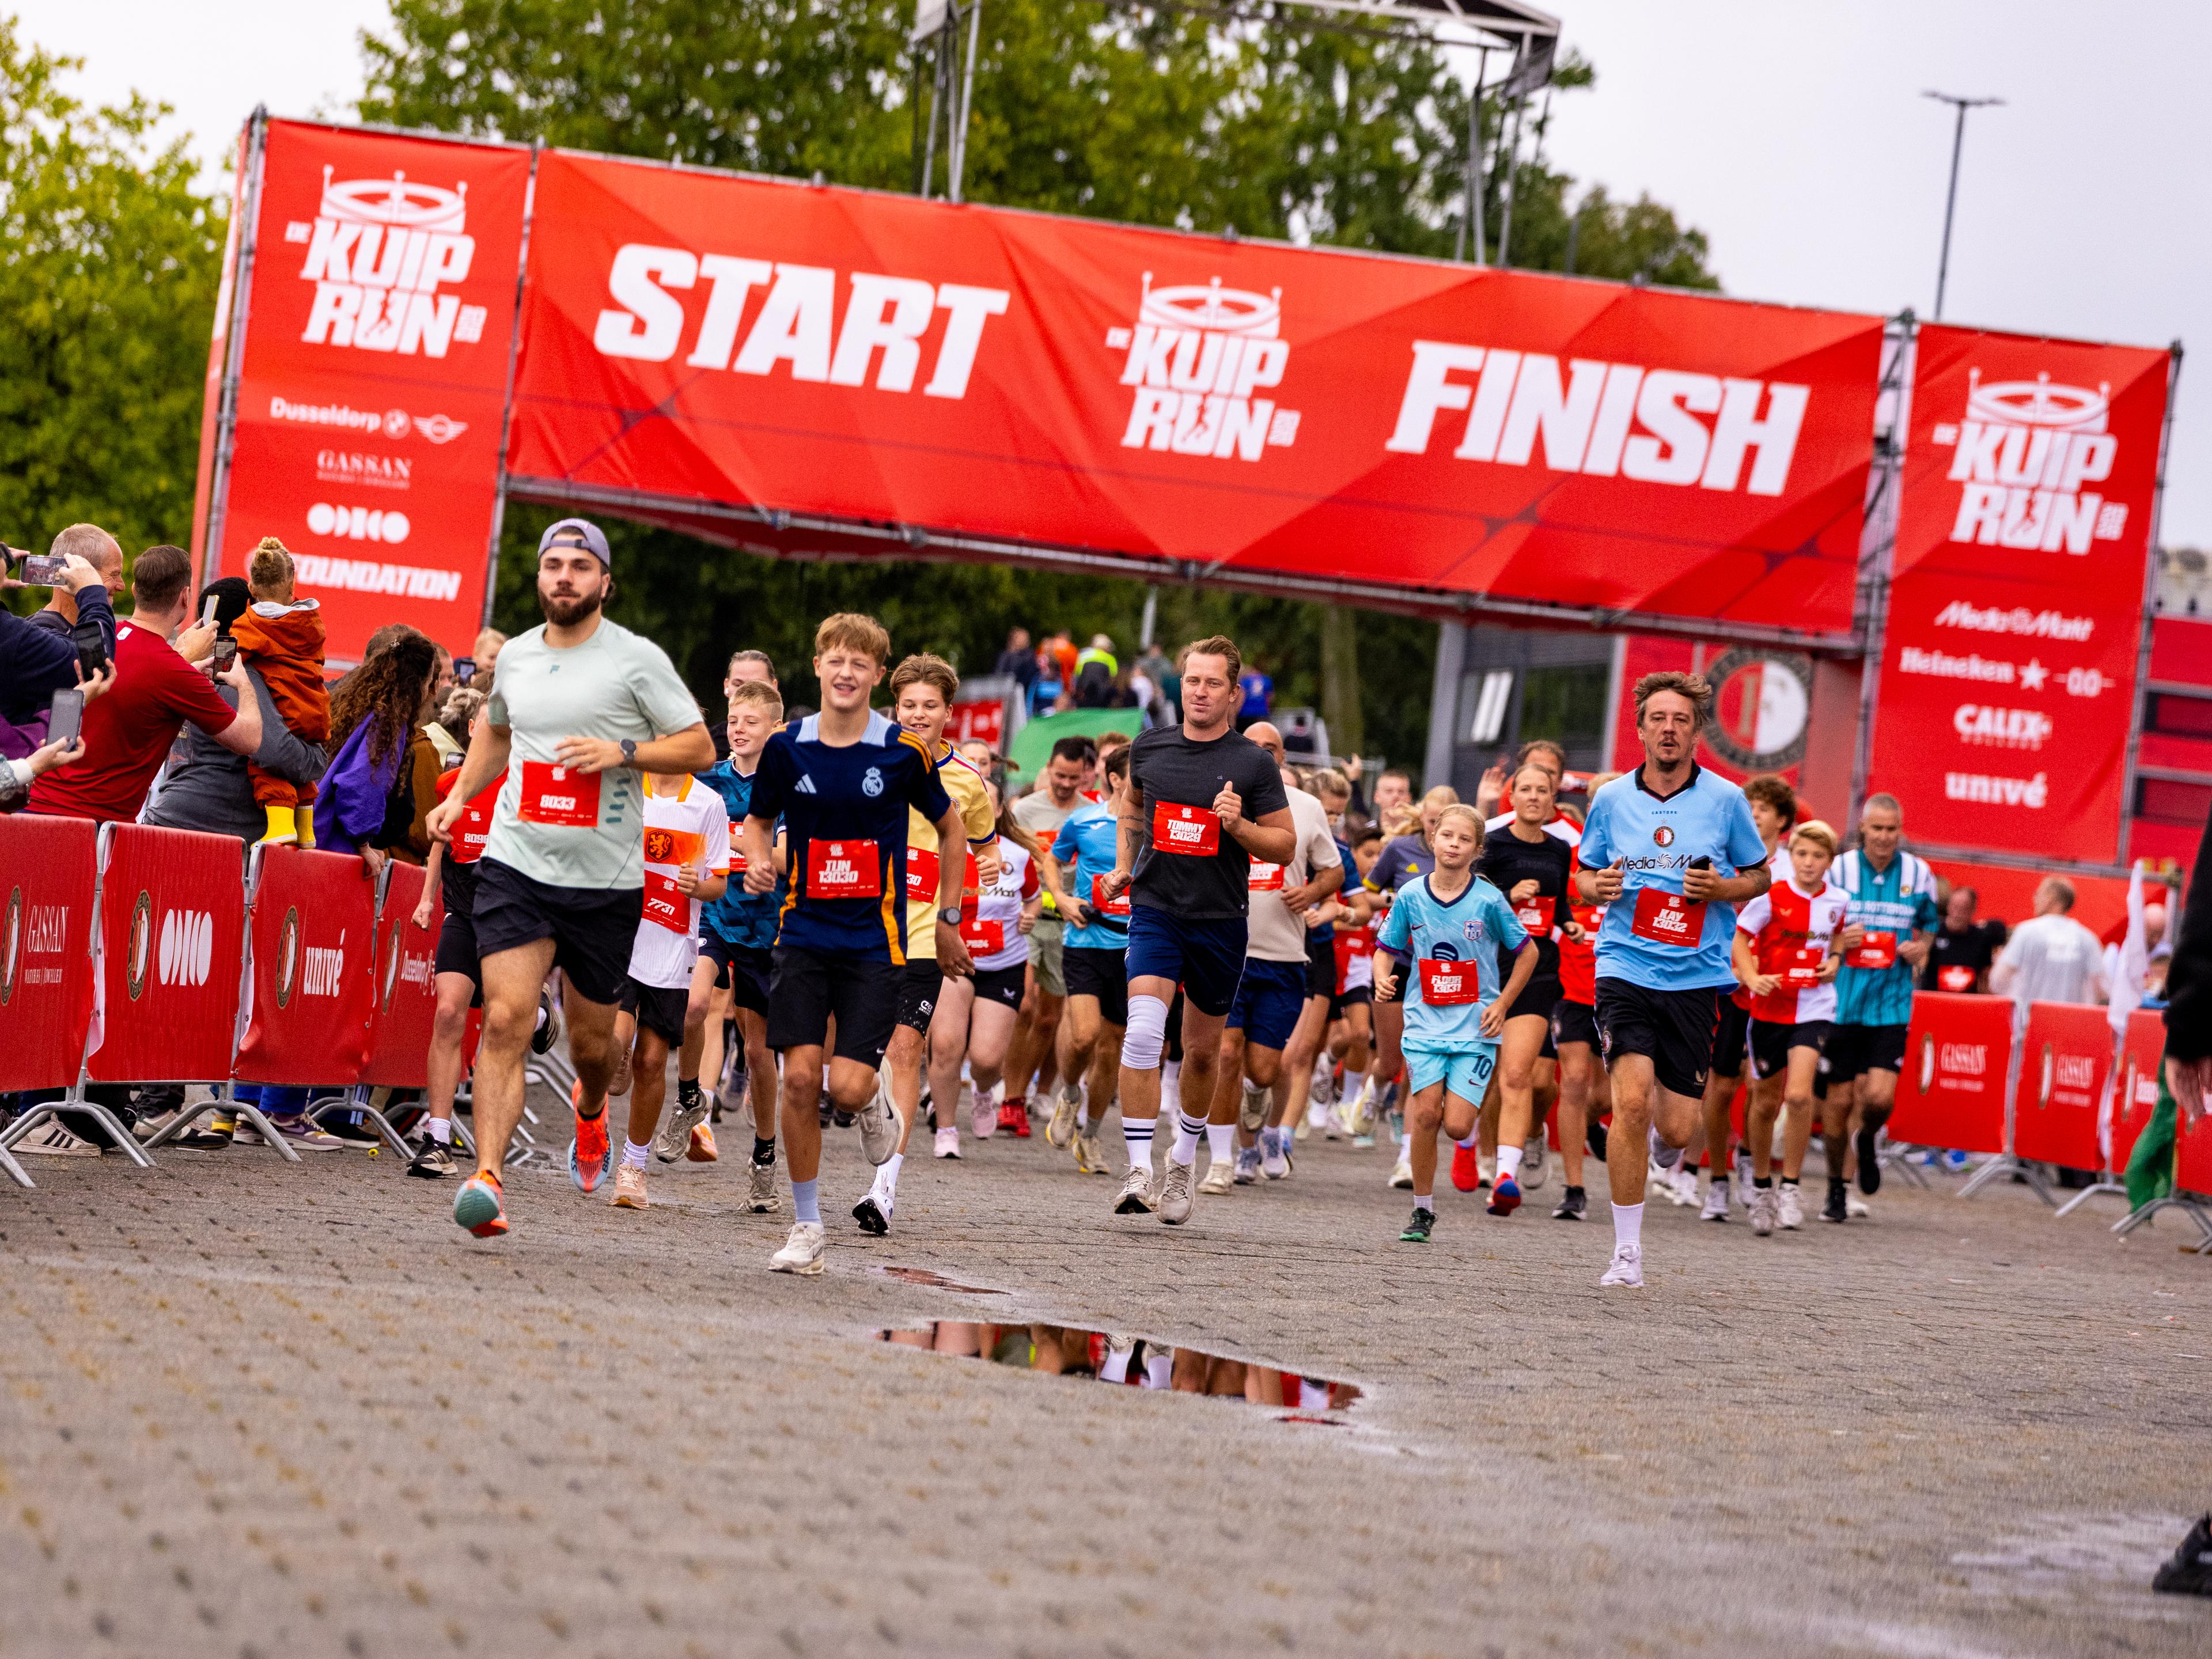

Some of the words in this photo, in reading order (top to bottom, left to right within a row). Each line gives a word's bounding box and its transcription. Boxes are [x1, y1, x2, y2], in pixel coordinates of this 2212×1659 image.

[300, 217, 475, 292] KUIP
[301, 282, 461, 359] RUN
[593, 243, 1010, 399] START
[1119, 323, 1290, 398] KUIP
[270, 396, 381, 433] Dusseldorp
[1121, 386, 1275, 462] RUN
[1384, 339, 1810, 497] FINISH
[317, 449, 411, 479] GASSAN
[1947, 419, 2119, 493] KUIP
[1948, 482, 2103, 556] RUN
[1899, 646, 2016, 684] Heineken
[540, 794, 576, 810] 8033
[1945, 772, 2048, 808] univé
[1167, 819, 1206, 834] TOMMY
[1169, 830, 1202, 843] 13029
[819, 870, 858, 884] 13030
[1622, 855, 1656, 870] Media
[647, 897, 676, 915] 7731
[1659, 908, 1685, 922] KAY
[28, 905, 69, 952] GASSAN
[1652, 916, 1688, 933] 13032
[304, 928, 346, 998] univé
[1431, 975, 1463, 984] FLOOR
[1433, 983, 1462, 993] 13031
[1472, 1055, 1493, 1079] 10
